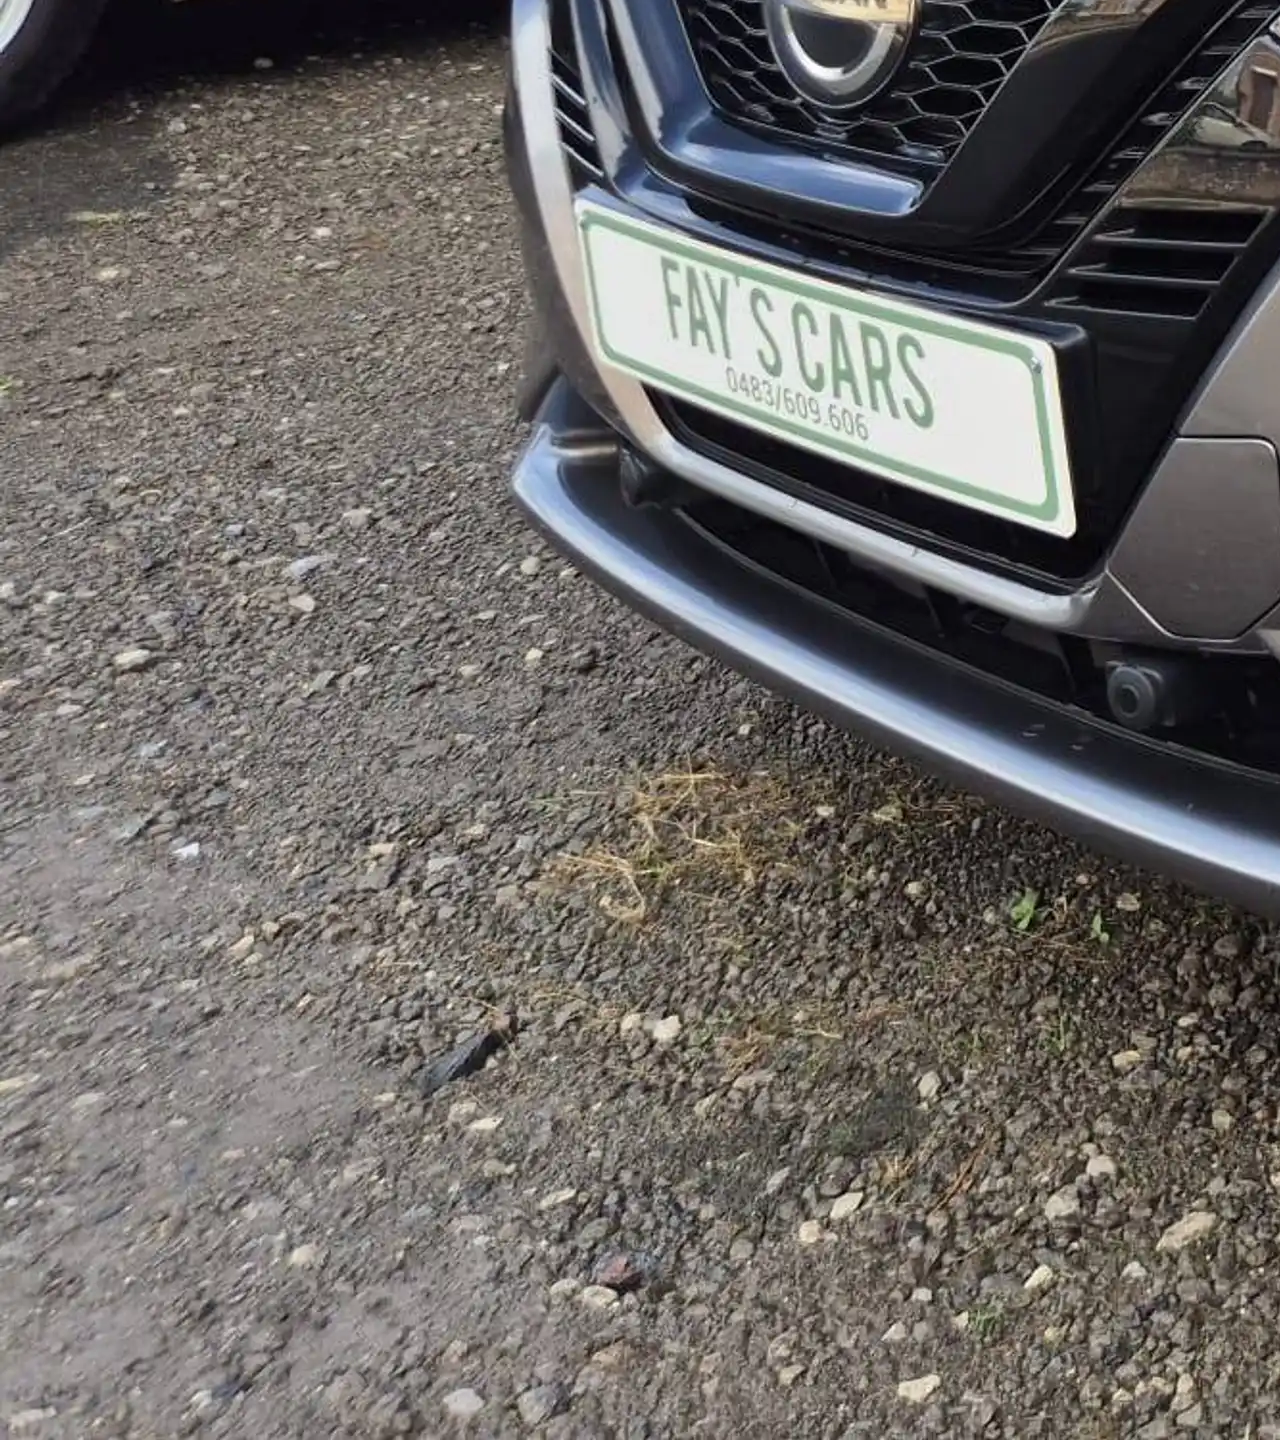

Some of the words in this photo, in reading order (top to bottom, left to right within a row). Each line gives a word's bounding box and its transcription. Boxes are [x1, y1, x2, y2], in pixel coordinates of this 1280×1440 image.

[660, 256, 783, 378] FAY'S
[793, 300, 936, 430] CARS
[725, 365, 870, 442] 0483/609.606
